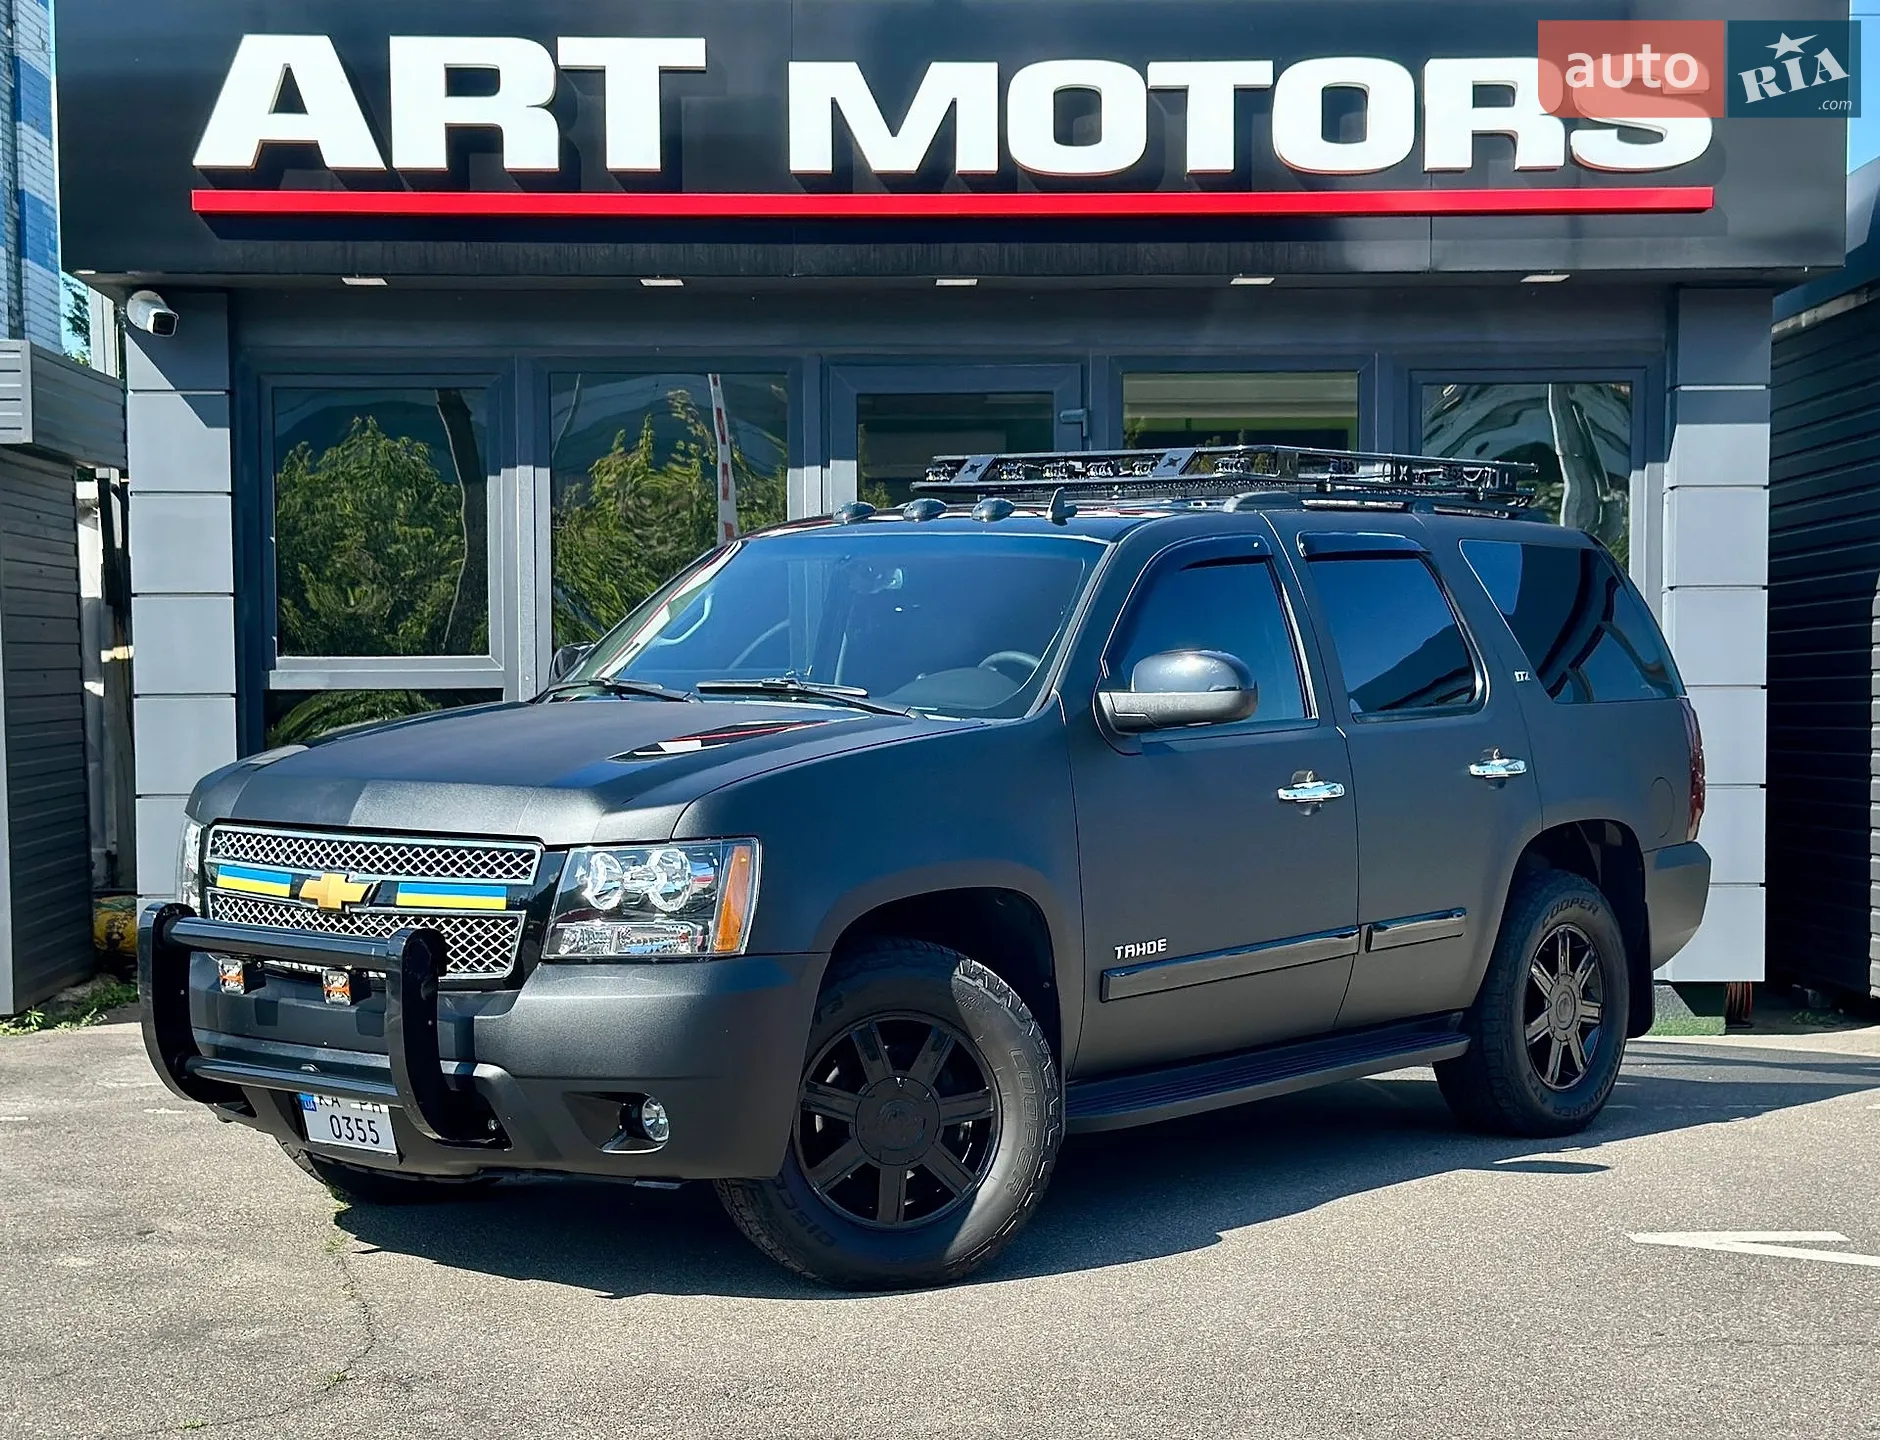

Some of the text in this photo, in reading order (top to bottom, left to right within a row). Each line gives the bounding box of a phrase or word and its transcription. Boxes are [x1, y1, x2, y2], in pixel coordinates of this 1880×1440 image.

[192, 34, 1714, 176] ART MOTORS
[1541, 897, 1600, 931] COOPER
[1114, 938, 1167, 960] TAHOE
[329, 1114, 380, 1145] 0355
